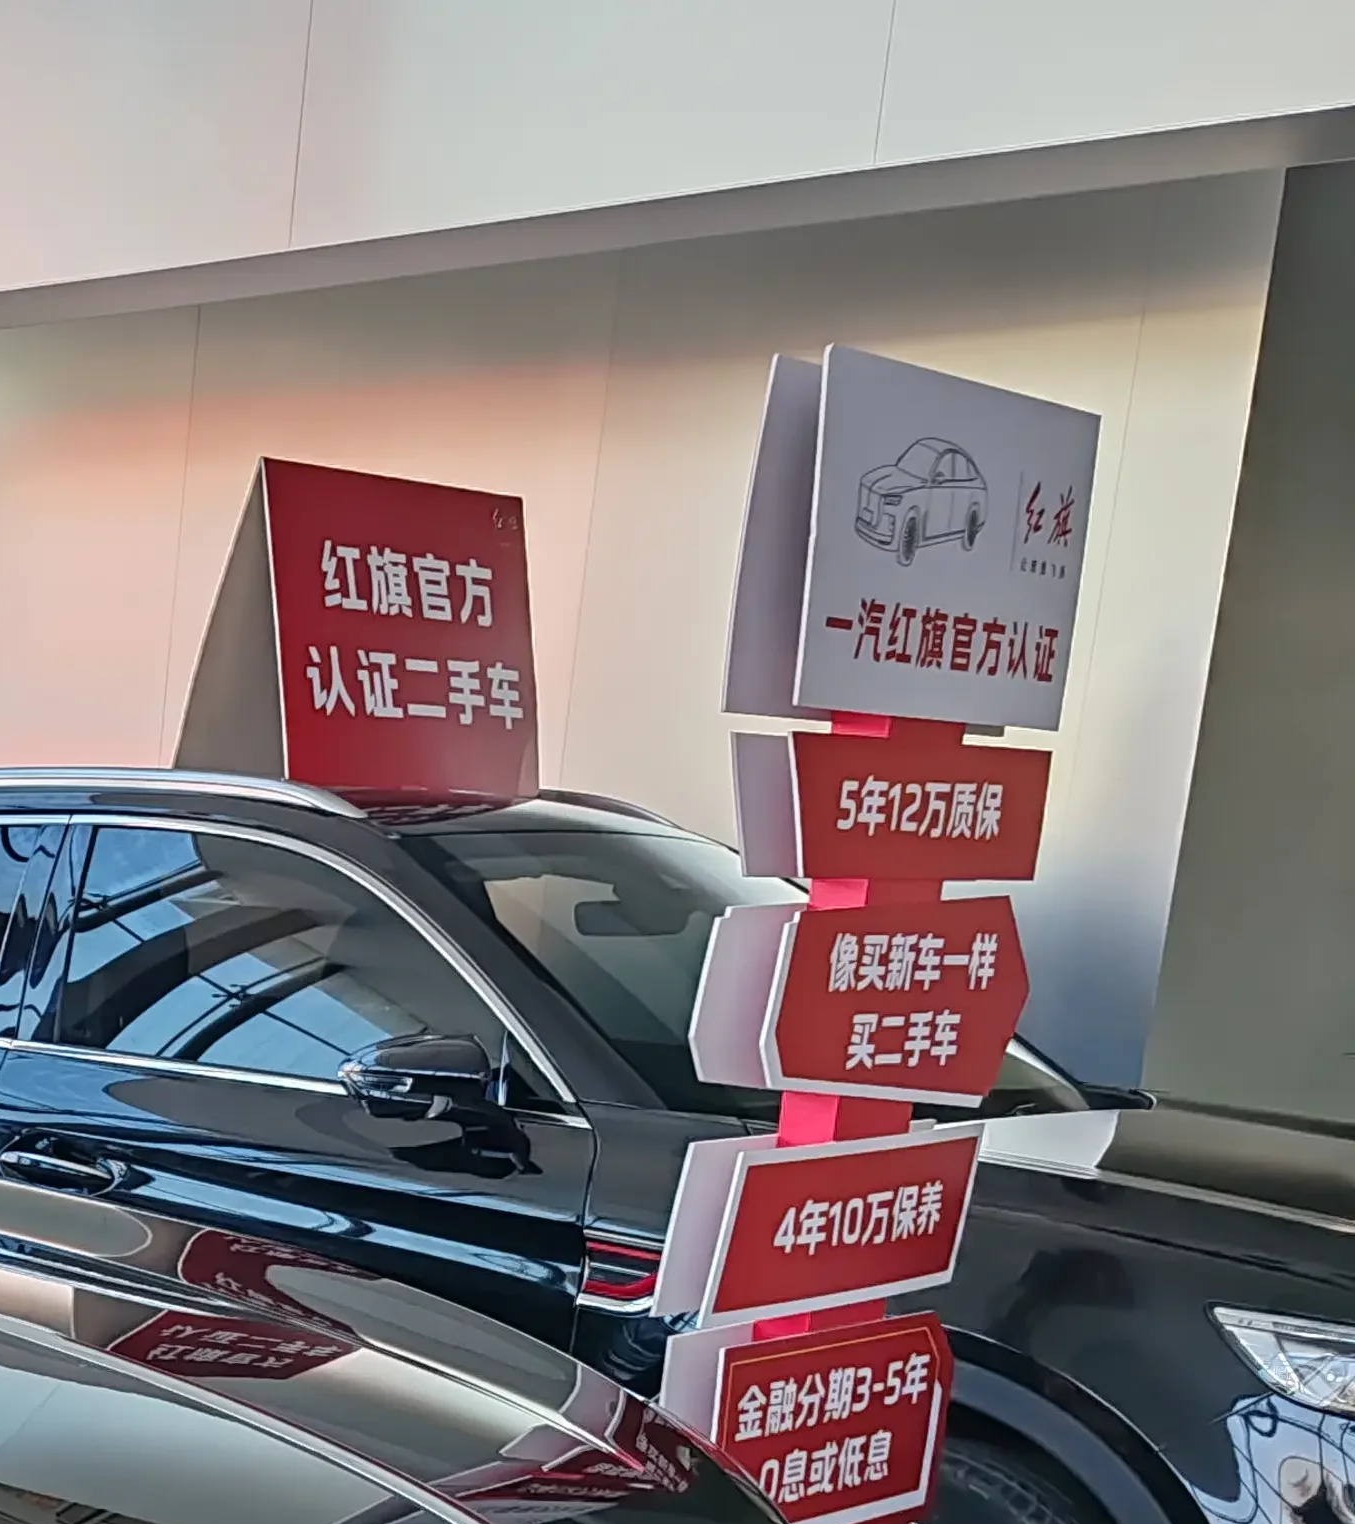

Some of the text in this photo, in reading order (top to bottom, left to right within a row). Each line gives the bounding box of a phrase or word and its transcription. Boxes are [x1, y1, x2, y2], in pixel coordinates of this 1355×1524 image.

[1024, 482, 1075, 547] 红旗
[321, 539, 493, 628] 红旗官方
[825, 598, 1059, 683] 一汽红旗官方认证
[306, 645, 524, 730] 认证二手车
[836, 775, 1003, 840] 5年12万质保
[829, 932, 1000, 993] 像买新车一样
[845, 1009, 962, 1071] 买二手车
[774, 1181, 944, 1256] 4年10万保养
[735, 1354, 931, 1442] 金融分期3-5年
[758, 1431, 892, 1504] 0息或低息
